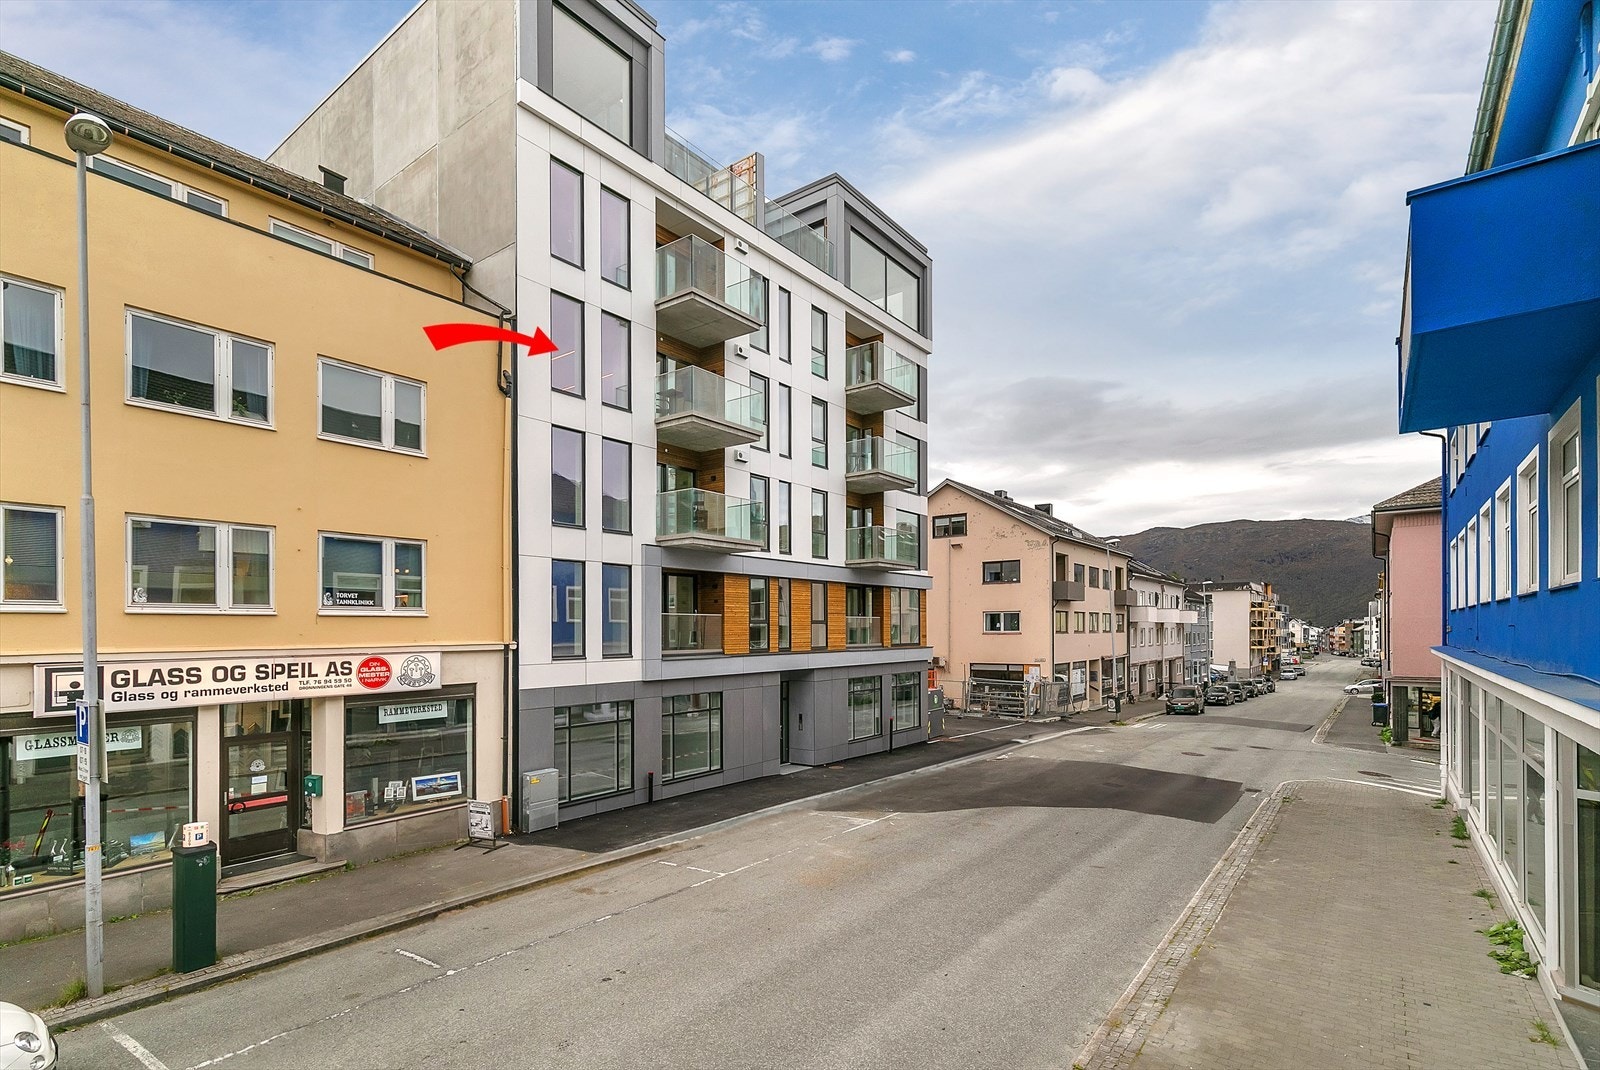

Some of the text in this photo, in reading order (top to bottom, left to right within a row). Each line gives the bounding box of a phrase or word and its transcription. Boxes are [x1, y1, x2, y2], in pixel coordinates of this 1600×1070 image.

[110, 660, 353, 689] GLASS OG SPEIL AS
[111, 682, 289, 703] Glass og rammeverksted
[79, 706, 87, 737] P
[383, 703, 443, 717] RAMMEVERKSTED
